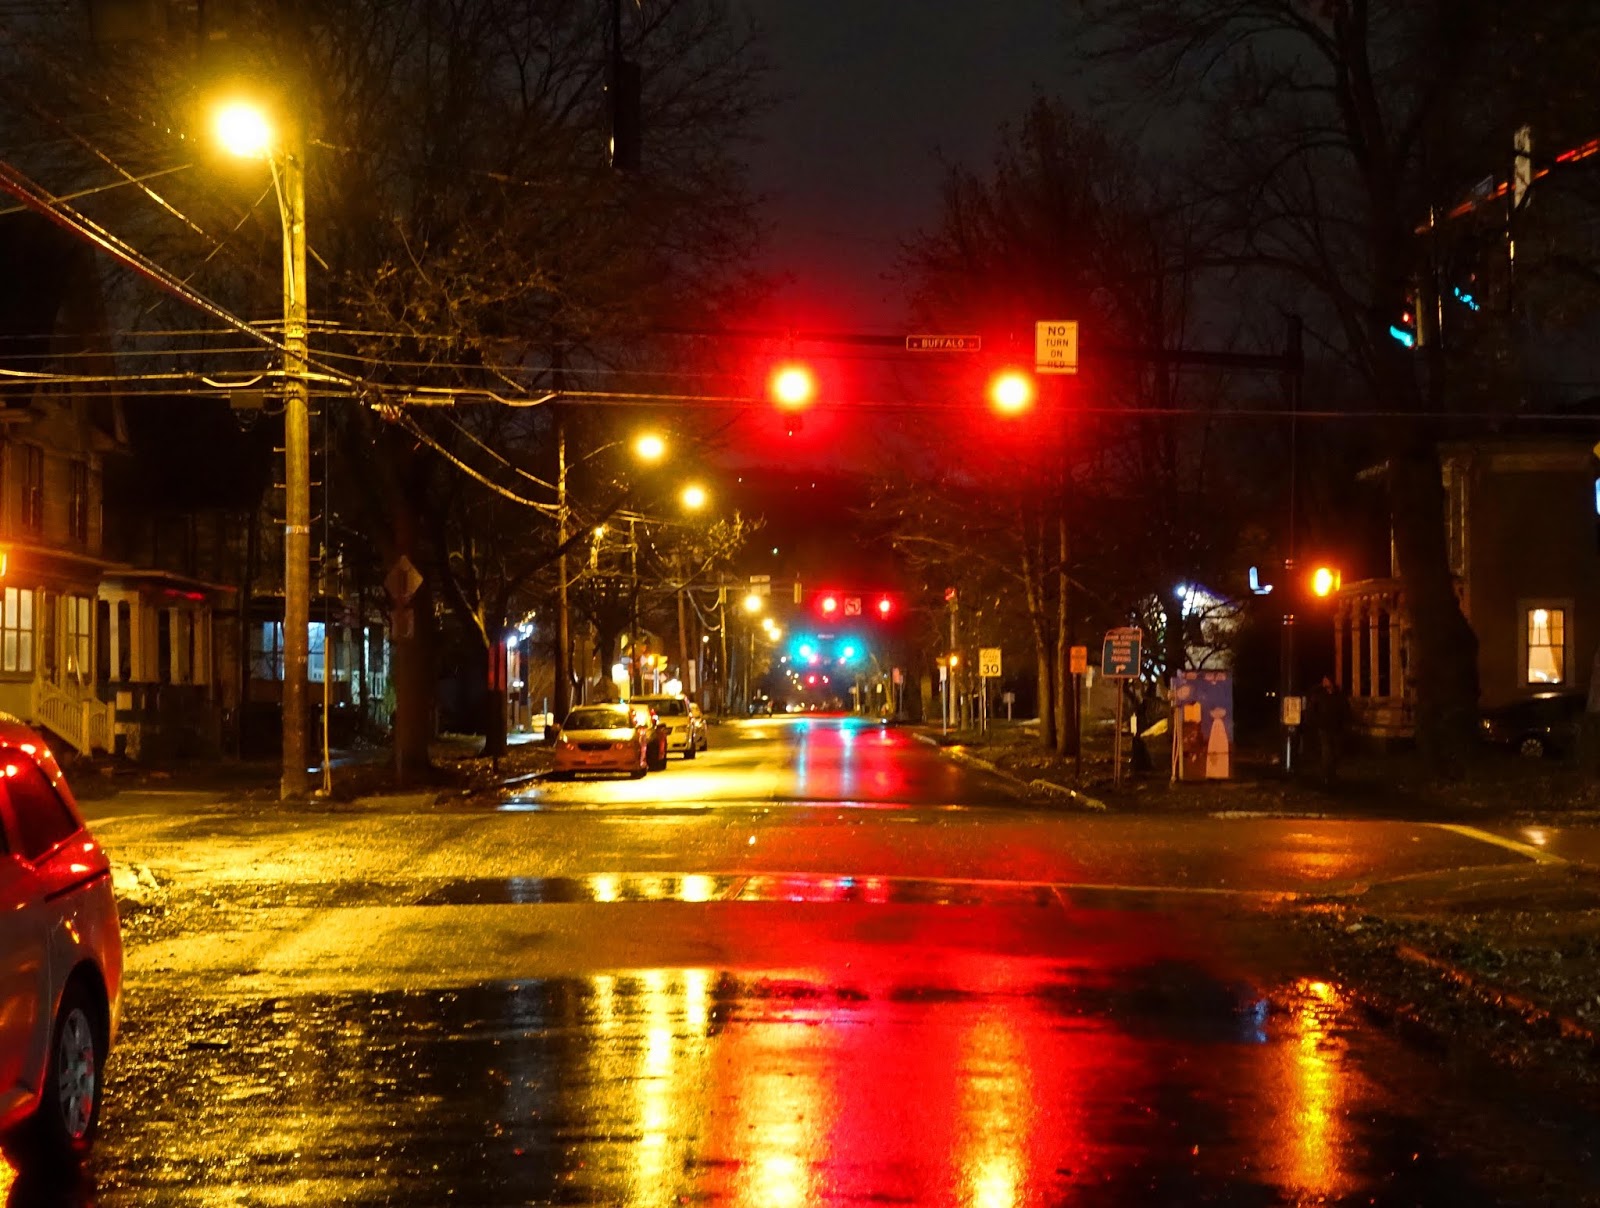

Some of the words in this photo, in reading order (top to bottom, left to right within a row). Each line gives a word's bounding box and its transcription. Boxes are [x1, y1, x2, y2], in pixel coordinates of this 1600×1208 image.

[1048, 326, 1066, 336] NO
[922, 339, 965, 348] BUFFALO
[1046, 339, 1069, 348] TURN
[1050, 350, 1063, 358] ON
[982, 664, 999, 674] 30
